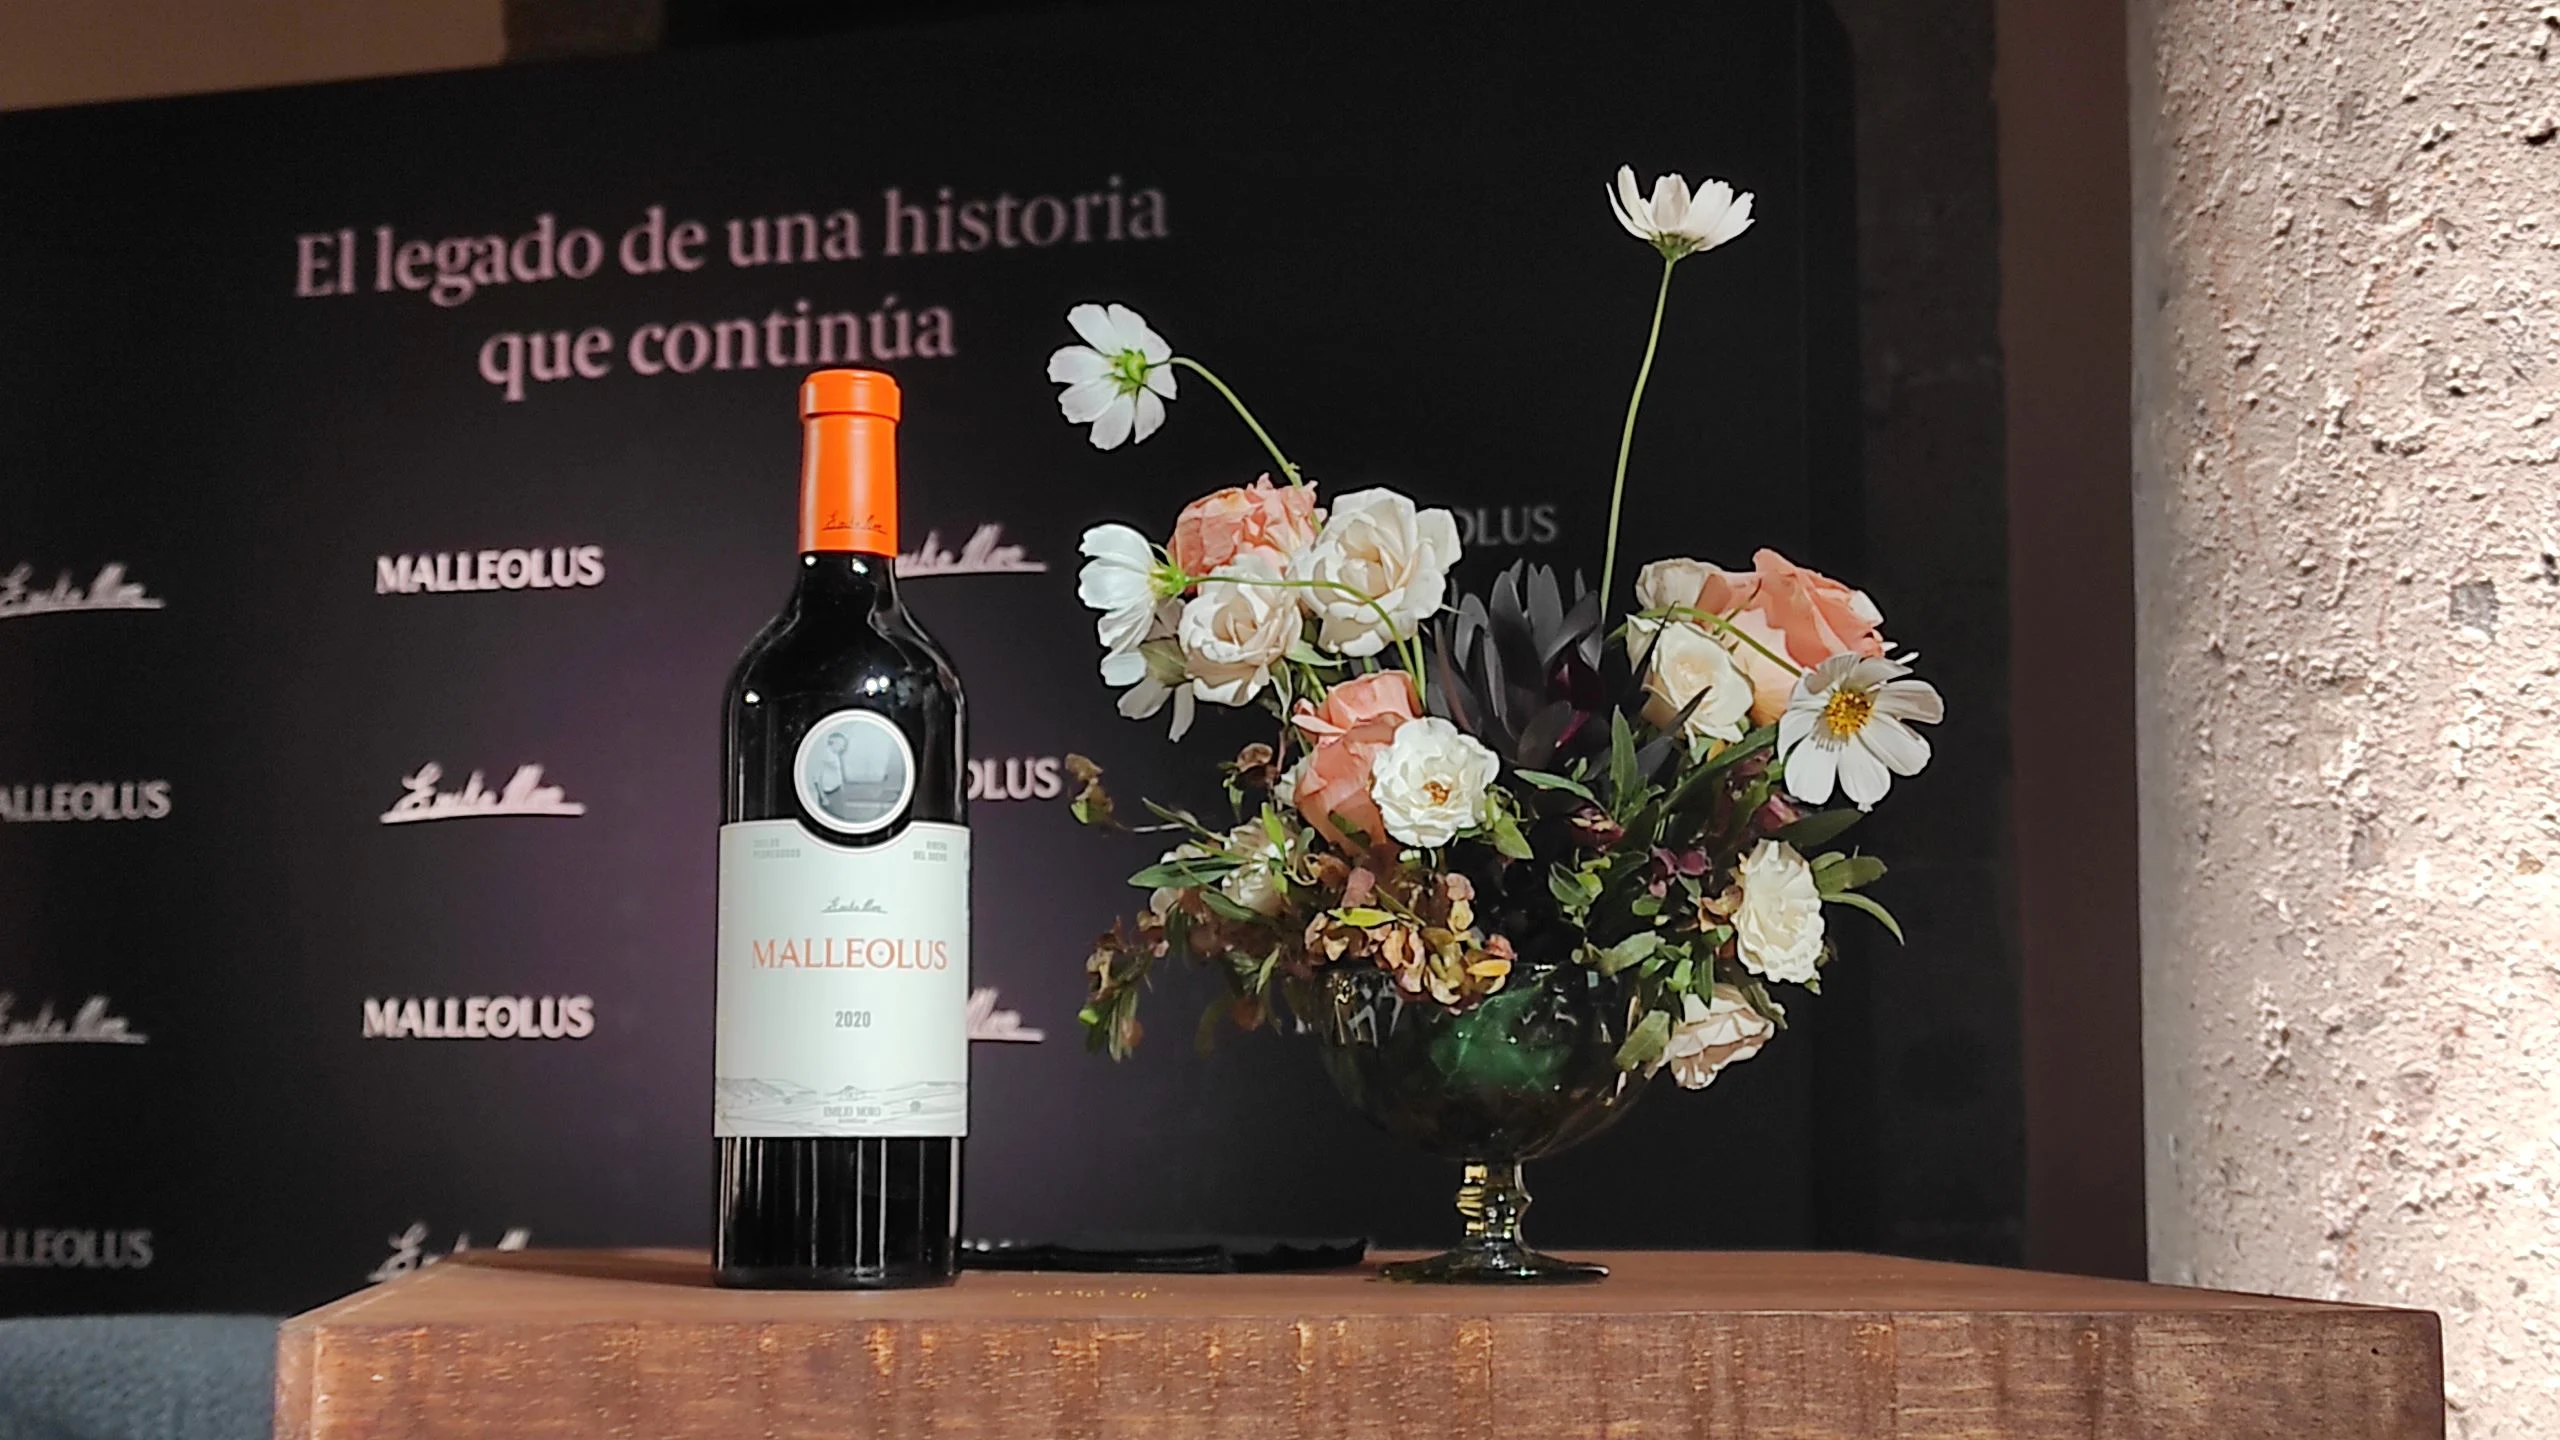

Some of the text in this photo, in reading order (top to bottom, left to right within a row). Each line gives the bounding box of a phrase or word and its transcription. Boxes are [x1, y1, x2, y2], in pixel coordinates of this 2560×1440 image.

[296, 173, 1168, 307] El legado de una historia
[479, 295, 957, 401] que continúa
[376, 546, 606, 594] MALLEOLUS
[752, 937, 948, 971] MALLEOLUS
[363, 995, 595, 1038] MALLEOLUS
[834, 1010, 871, 1028] 2020
